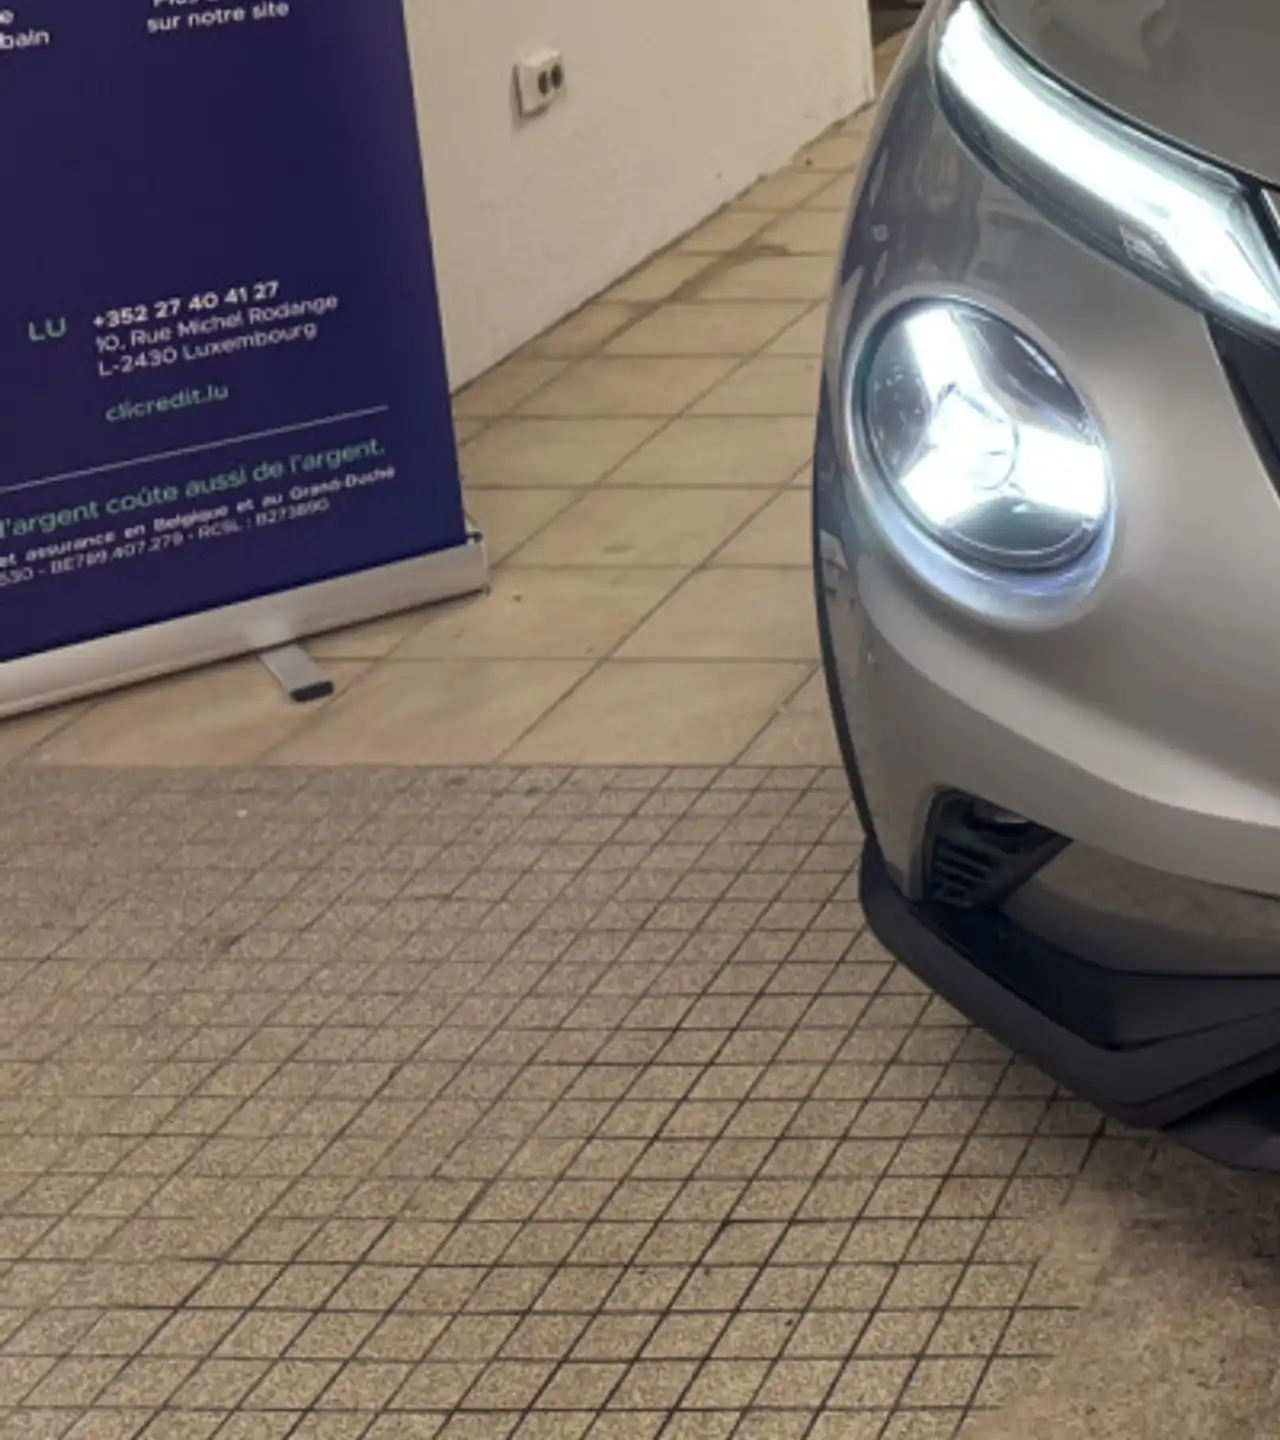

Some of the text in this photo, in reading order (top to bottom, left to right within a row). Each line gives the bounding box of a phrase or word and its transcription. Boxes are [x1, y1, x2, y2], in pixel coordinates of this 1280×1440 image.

[147, 0, 290, 34] sur notre site
[93, 280, 280, 328] +352 27 40 41 27
[131, 326, 173, 347] Rue
[178, 310, 244, 338] Michel
[249, 295, 338, 325] Rodange
[29, 316, 67, 341] LU
[98, 322, 317, 377] L-2430 Luxembourg
[185, 467, 248, 497] aussi
[253, 460, 284, 482] de
[124, 523, 147, 539] en
